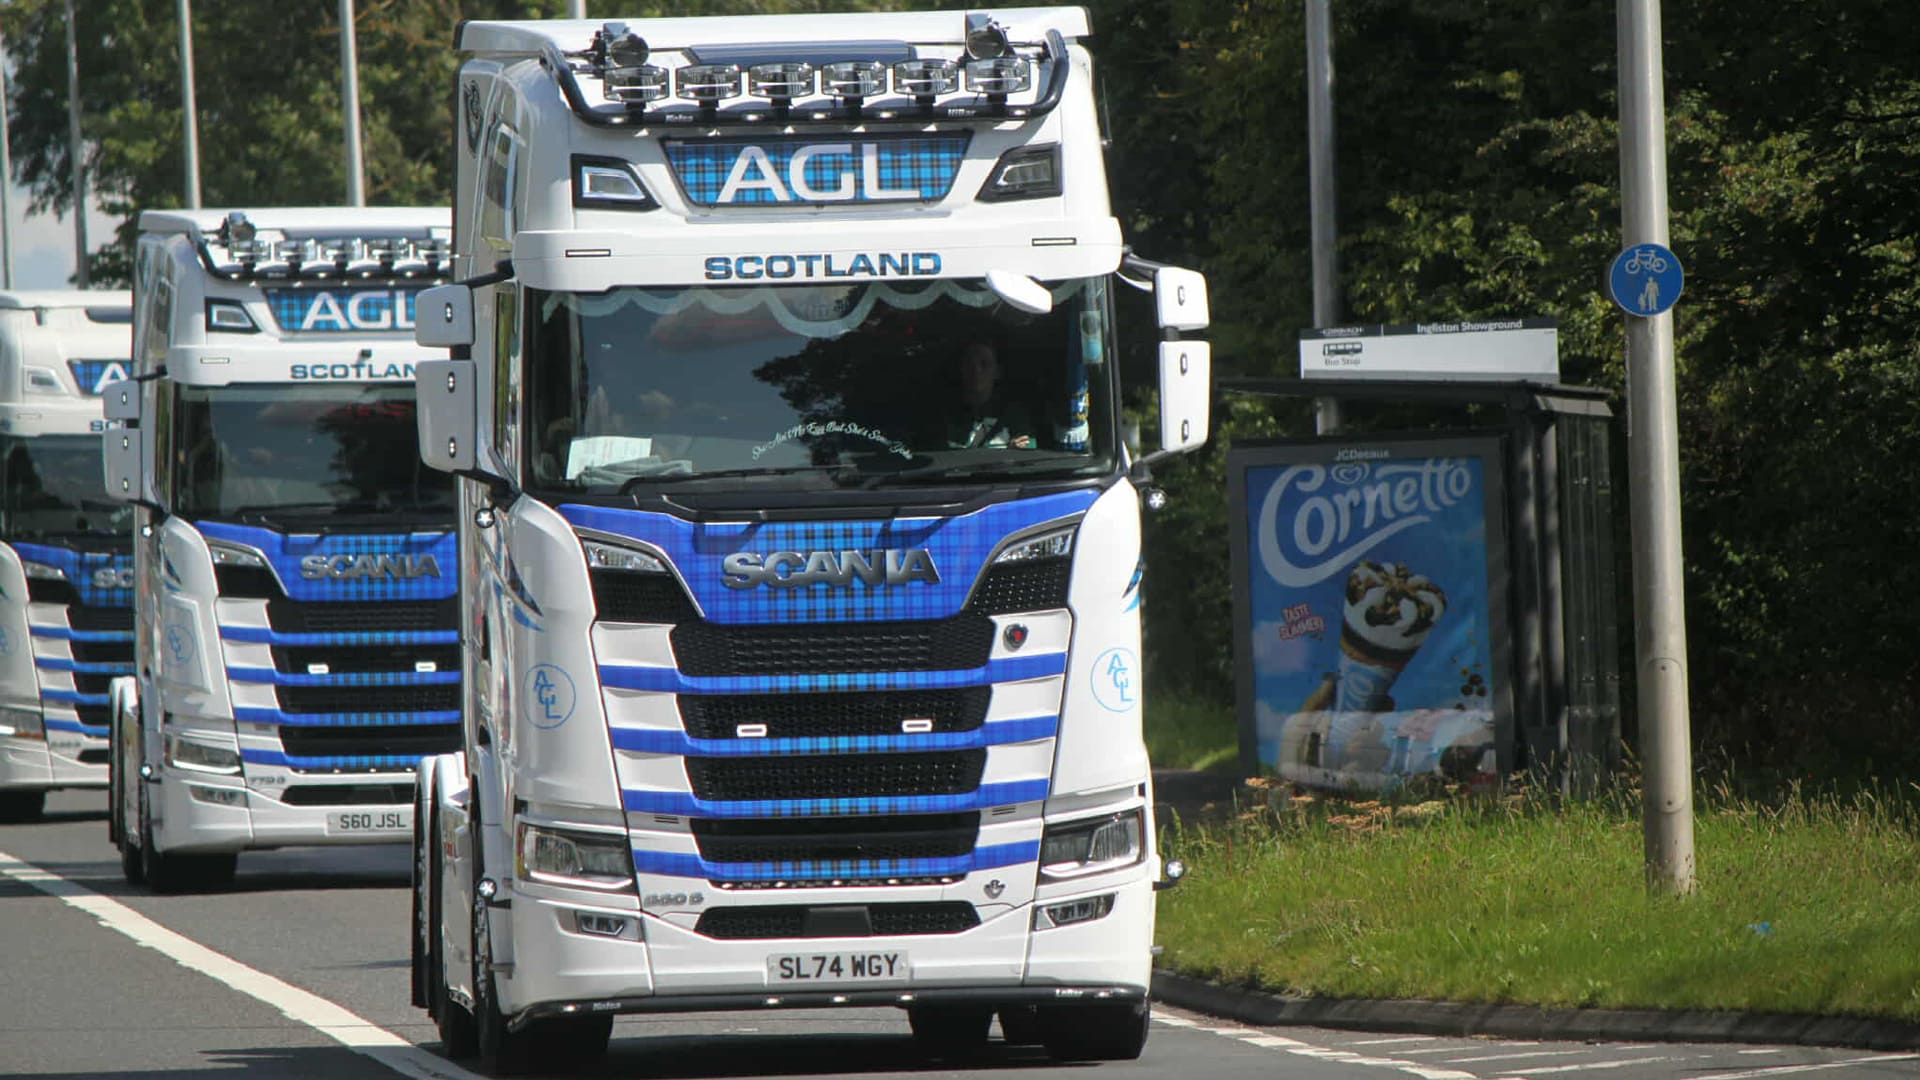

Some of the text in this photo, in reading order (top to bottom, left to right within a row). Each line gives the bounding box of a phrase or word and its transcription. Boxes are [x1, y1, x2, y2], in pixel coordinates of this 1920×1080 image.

[716, 143, 921, 203] AGL
[704, 253, 942, 280] SCOTLAND
[302, 290, 417, 330] AGL
[1416, 318, 1523, 335] Ingliston Showground
[290, 363, 417, 380] SCOTLAN
[1258, 457, 1472, 588] Cornetto
[301, 553, 442, 580] SCANIA
[722, 548, 942, 589] SCANIA
[340, 813, 407, 830] S60 JSL
[779, 952, 898, 979] SL74 WGY
